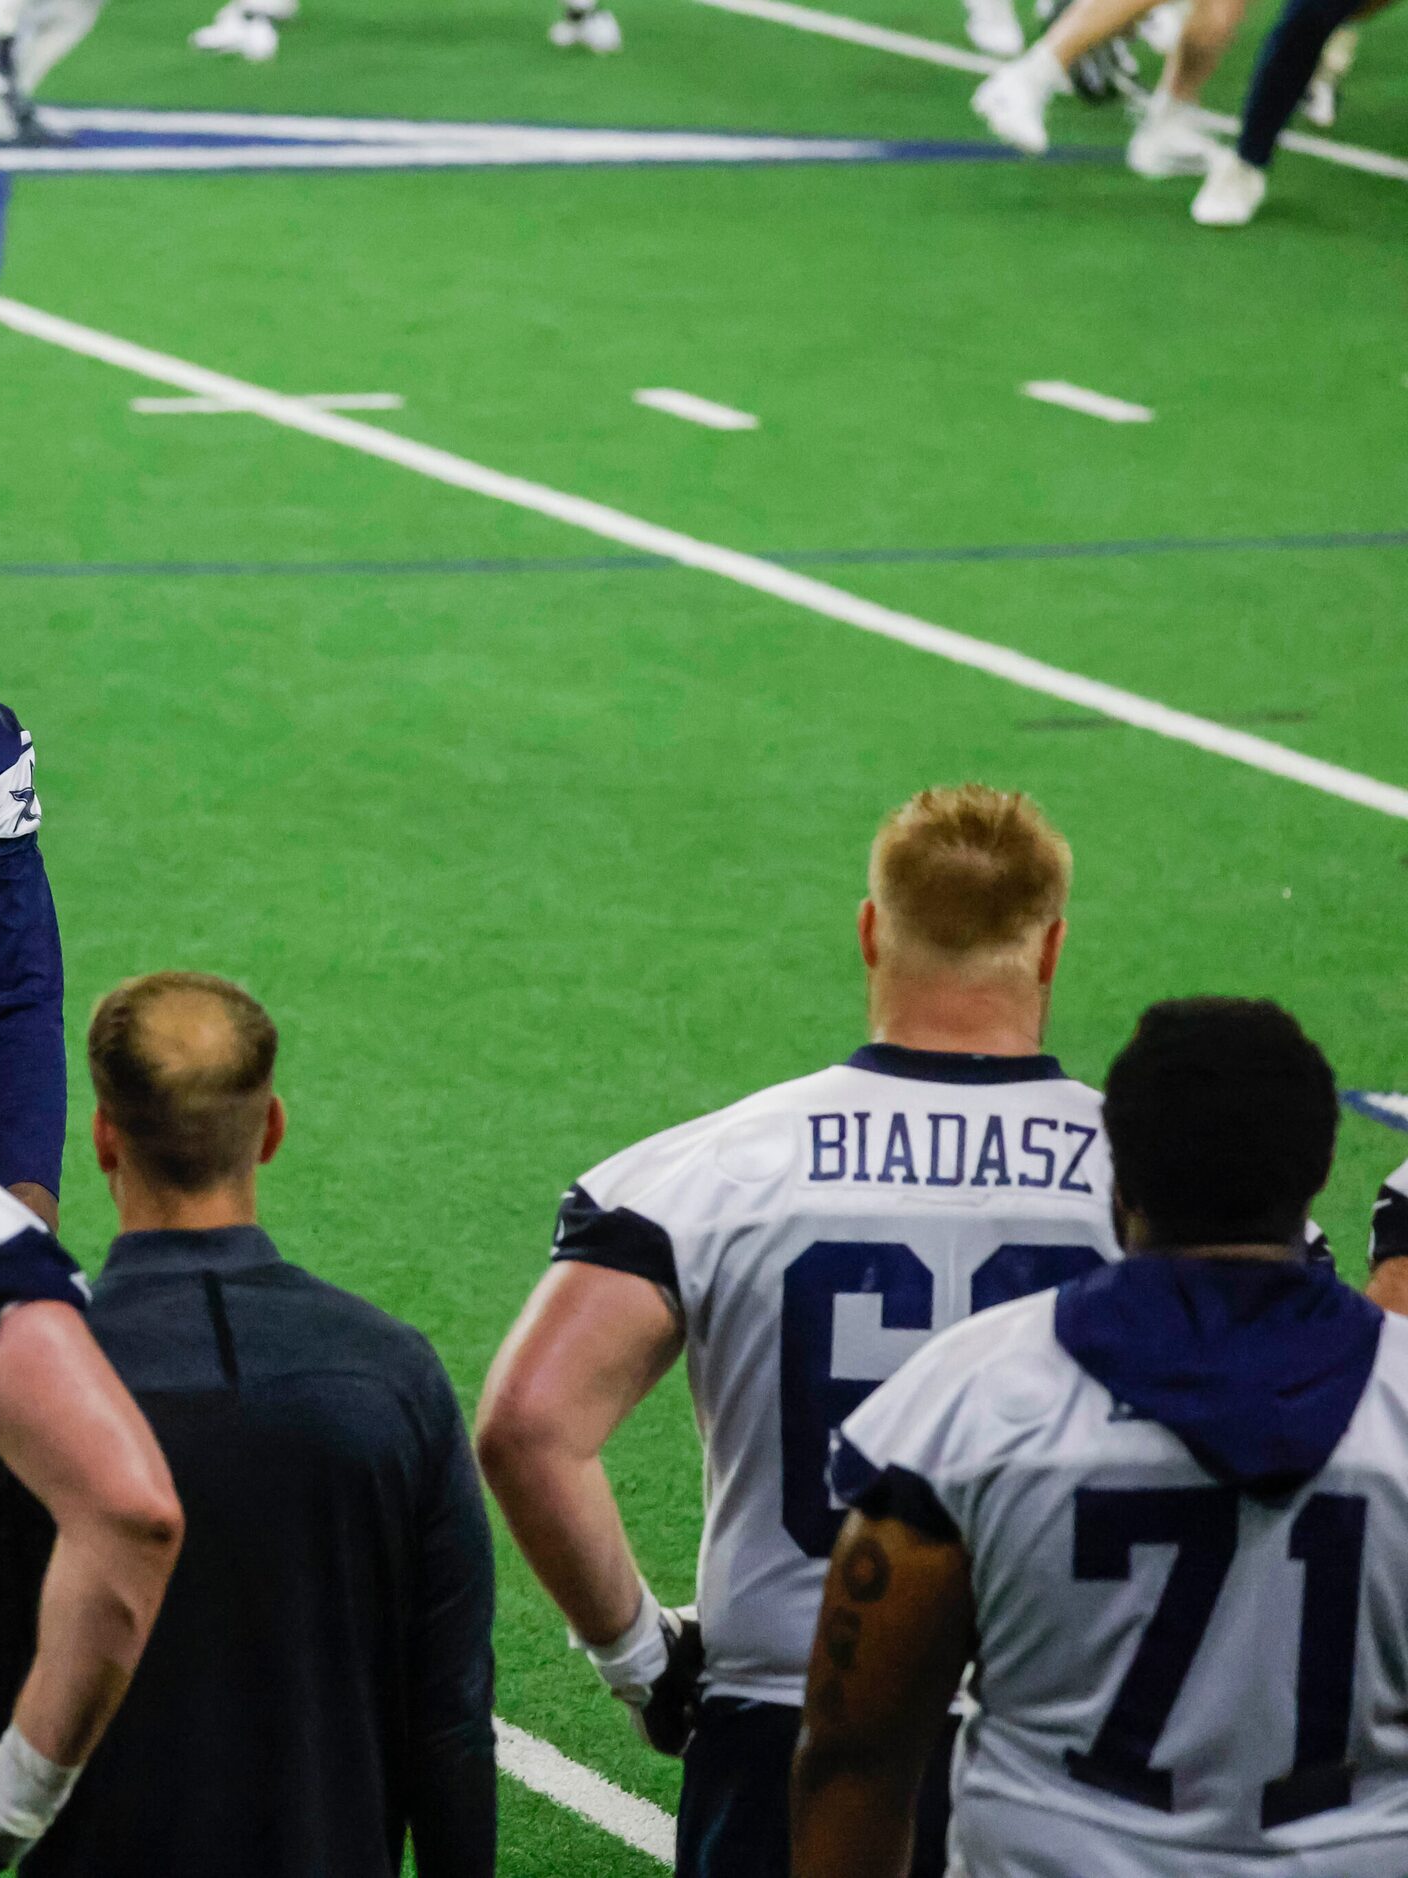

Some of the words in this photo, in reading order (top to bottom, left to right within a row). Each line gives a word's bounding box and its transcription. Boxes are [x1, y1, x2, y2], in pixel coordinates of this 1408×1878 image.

[807, 1111, 1097, 1194] BIADASZ
[780, 1240, 1109, 1559] 6
[1062, 1486, 1367, 1830] 71
